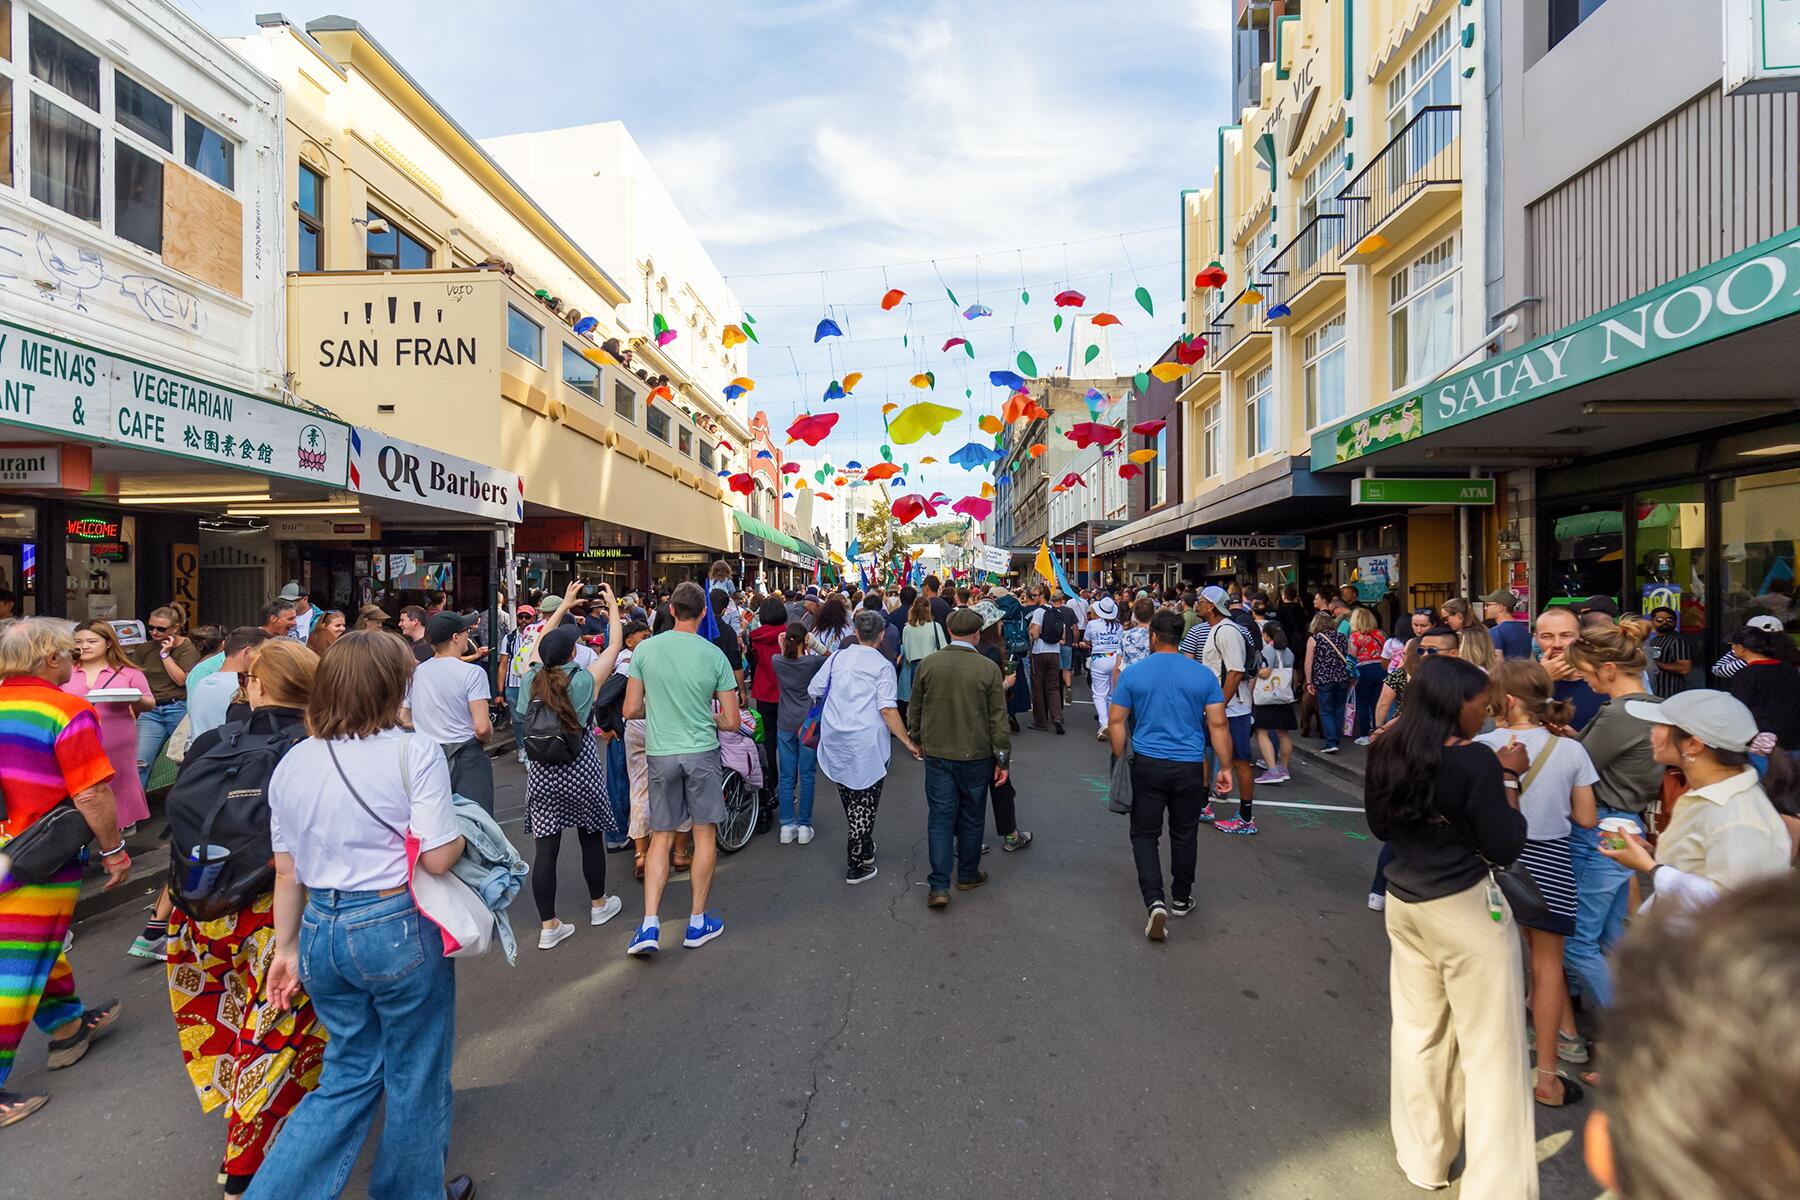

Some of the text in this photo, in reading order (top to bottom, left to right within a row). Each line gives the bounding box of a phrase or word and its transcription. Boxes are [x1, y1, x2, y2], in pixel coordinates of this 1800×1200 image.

[1293, 58, 1314, 102] VIC
[446, 284, 473, 296] VOID
[1438, 242, 1800, 419] SATAY NOO
[319, 337, 476, 367] SAN FRAN
[20, 339, 96, 387] MENA'S
[132, 370, 233, 422] VEGETARIAN
[0, 377, 165, 443] NT & CAFE
[183, 424, 275, 464] 松園素食館
[377, 445, 508, 506] QR Barbers
[1459, 487, 1488, 499] ATM
[67, 520, 118, 537] WELCOME
[1220, 536, 1276, 548] VINTAGE
[606, 549, 621, 557] NUN
